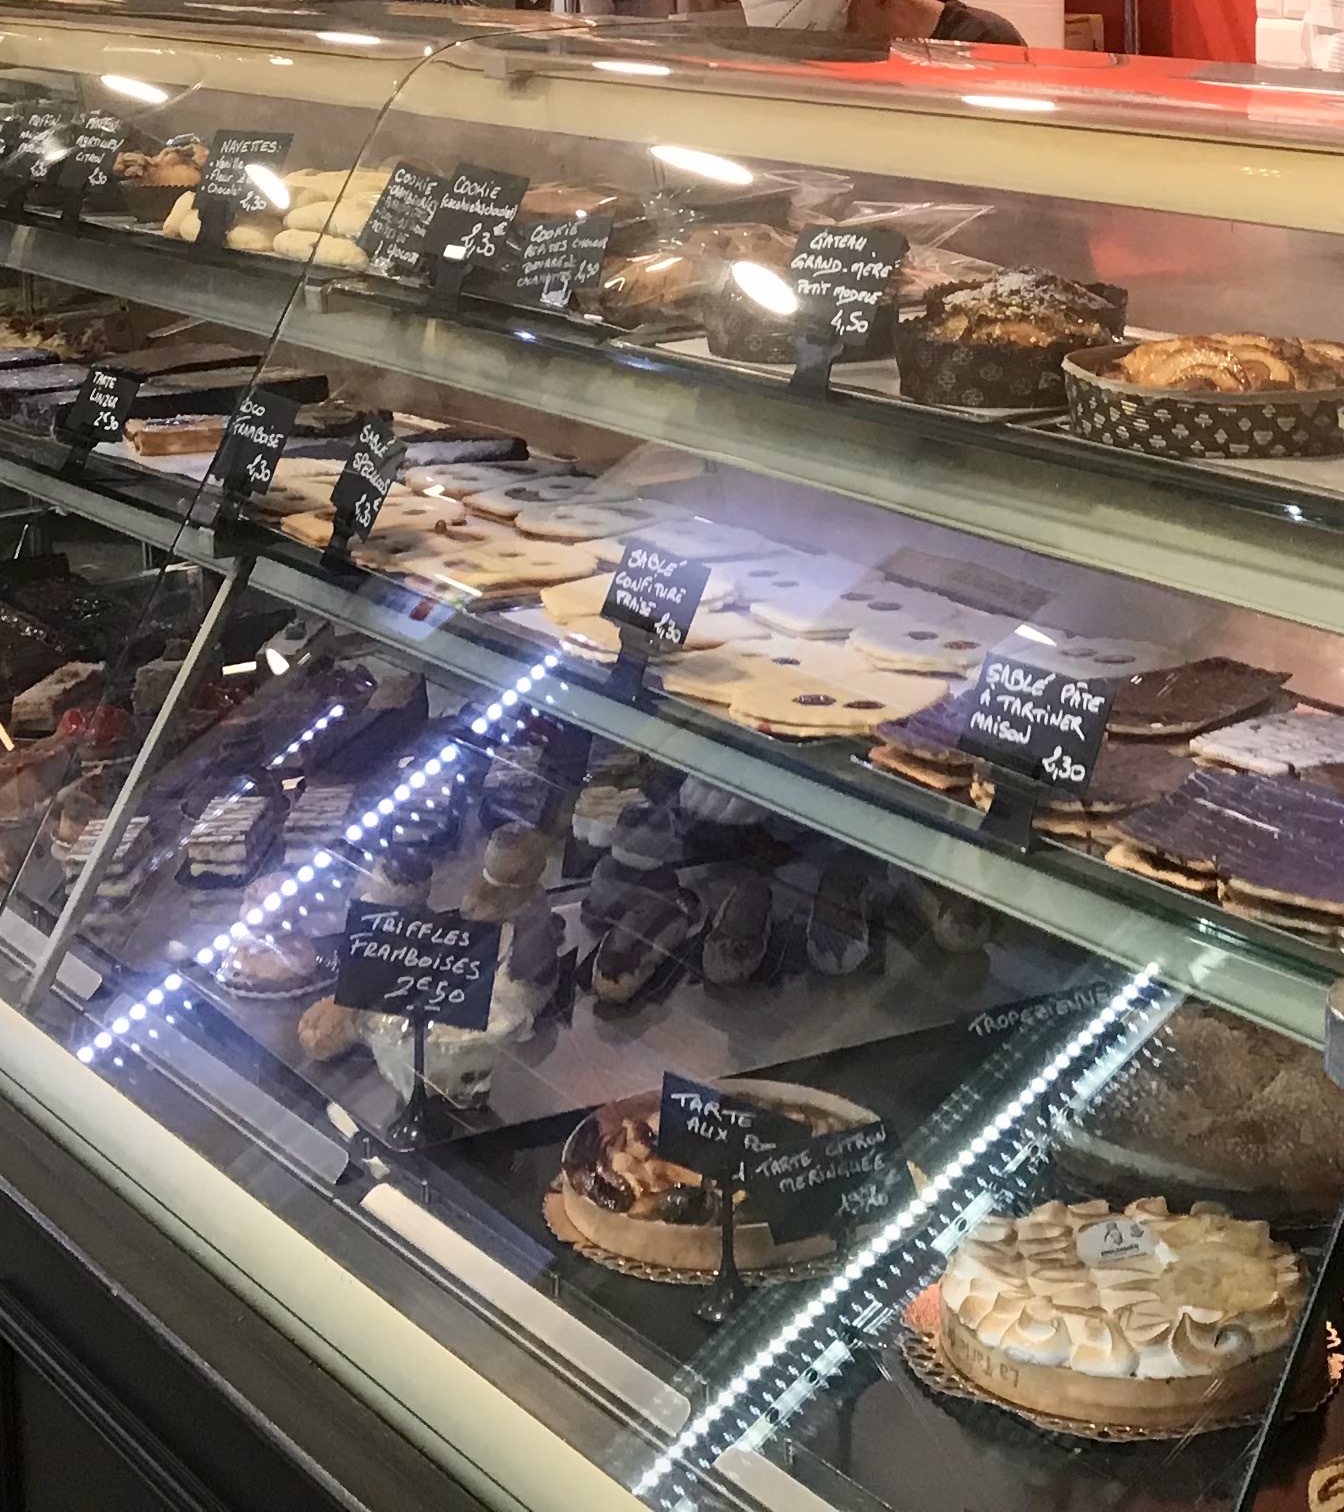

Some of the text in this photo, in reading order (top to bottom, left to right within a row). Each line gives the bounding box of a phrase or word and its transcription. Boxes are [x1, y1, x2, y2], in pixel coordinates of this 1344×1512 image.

[453, 176, 502, 199] COOKIE
[970, 711, 1031, 744] MAISON
[997, 695, 1085, 741] TARTINER
[361, 911, 470, 947] TRIFFLES
[350, 933, 480, 980] FRAMBOISES
[756, 1124, 886, 1178] TARTE CITRON
